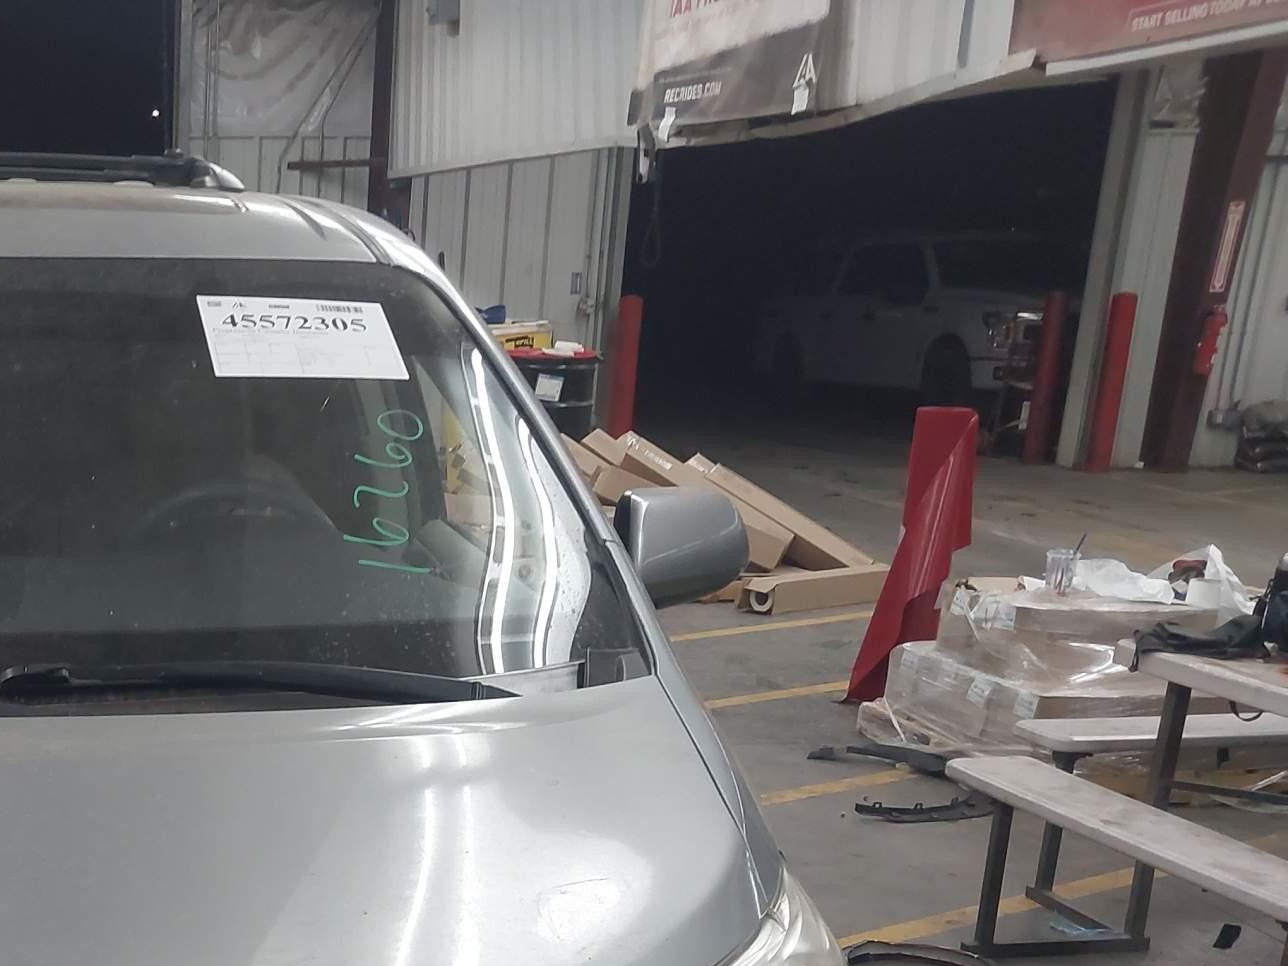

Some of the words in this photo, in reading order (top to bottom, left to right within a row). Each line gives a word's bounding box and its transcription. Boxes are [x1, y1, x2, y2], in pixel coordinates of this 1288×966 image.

[1131, 12, 1163, 33] START
[1165, 3, 1208, 25] SELLING
[664, 80, 722, 103] RECRIDES.COM
[222, 313, 367, 333] 45572305
[344, 409, 431, 574] 16260
